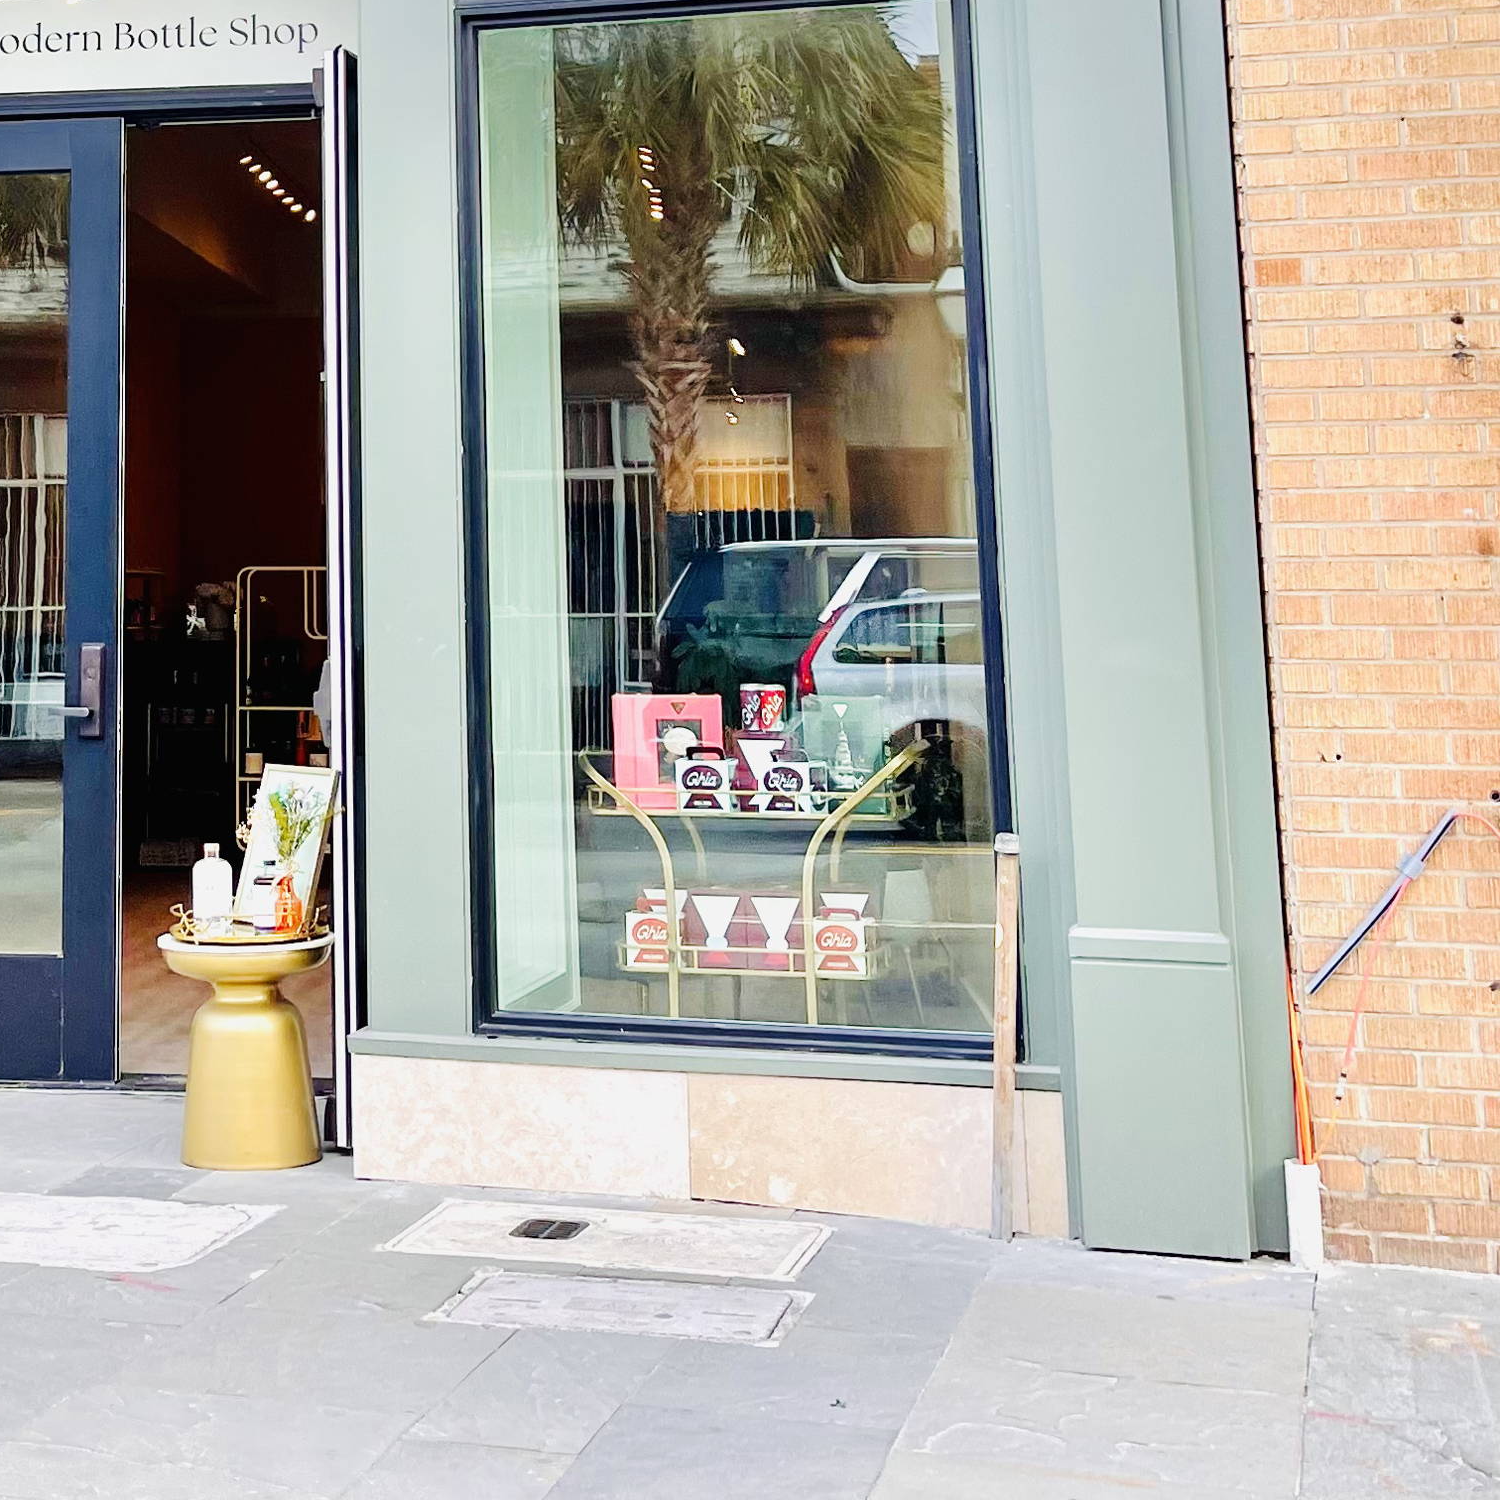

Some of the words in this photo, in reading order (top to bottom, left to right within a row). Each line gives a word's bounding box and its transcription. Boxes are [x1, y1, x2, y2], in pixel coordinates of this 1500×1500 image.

[115, 16, 218, 51] Bottle
[229, 14, 319, 54] Shop
[686, 770, 718, 788] Ghia
[820, 932, 854, 948] Ghia
